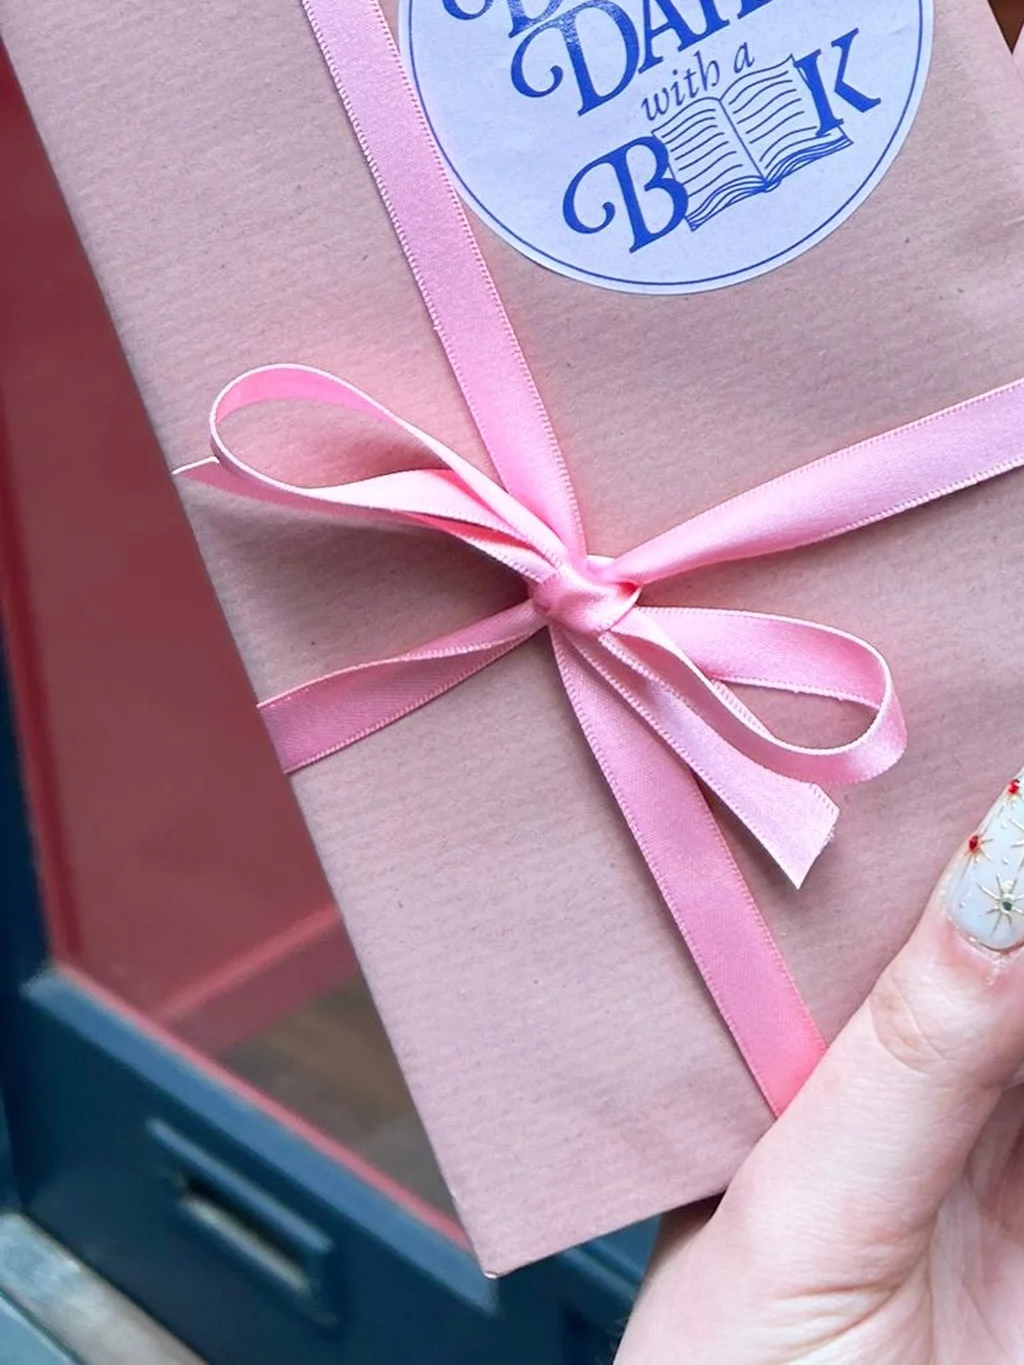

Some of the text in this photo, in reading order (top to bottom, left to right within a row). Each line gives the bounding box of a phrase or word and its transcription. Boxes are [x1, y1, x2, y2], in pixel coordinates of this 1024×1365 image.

[562, 27, 882, 254] BK
[640, 41, 756, 122] with a
